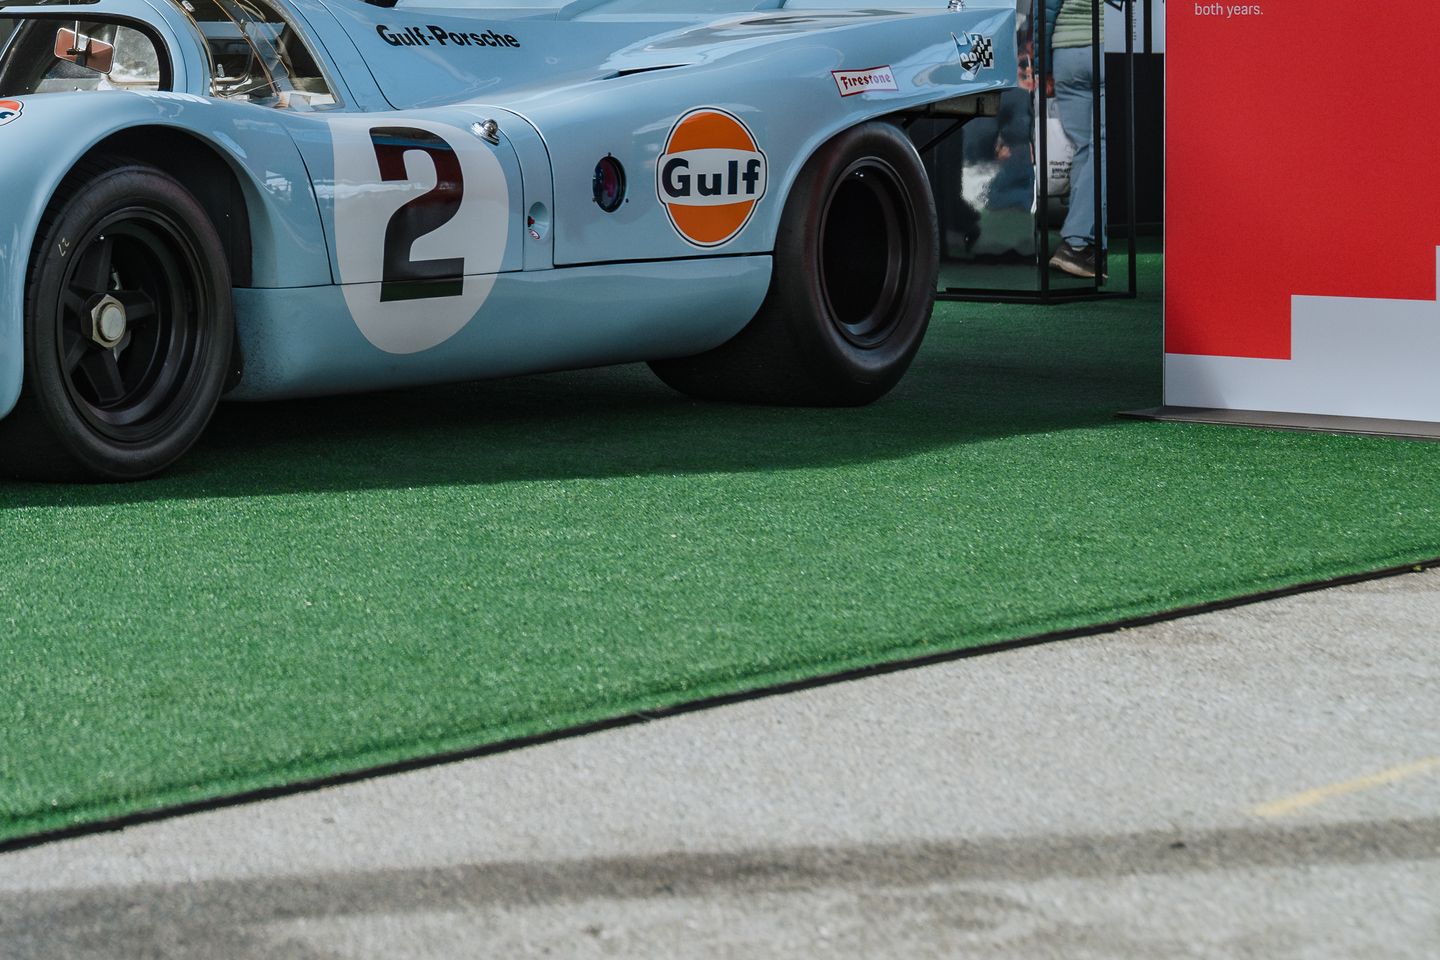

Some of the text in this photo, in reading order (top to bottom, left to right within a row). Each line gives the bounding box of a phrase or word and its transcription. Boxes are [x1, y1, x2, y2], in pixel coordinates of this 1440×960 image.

[1194, 2, 1263, 18] both years.
[376, 24, 521, 48] Gulf-Porsche
[841, 74, 891, 90] Firestone
[662, 158, 761, 198] Gulf
[369, 126, 465, 302] 2
